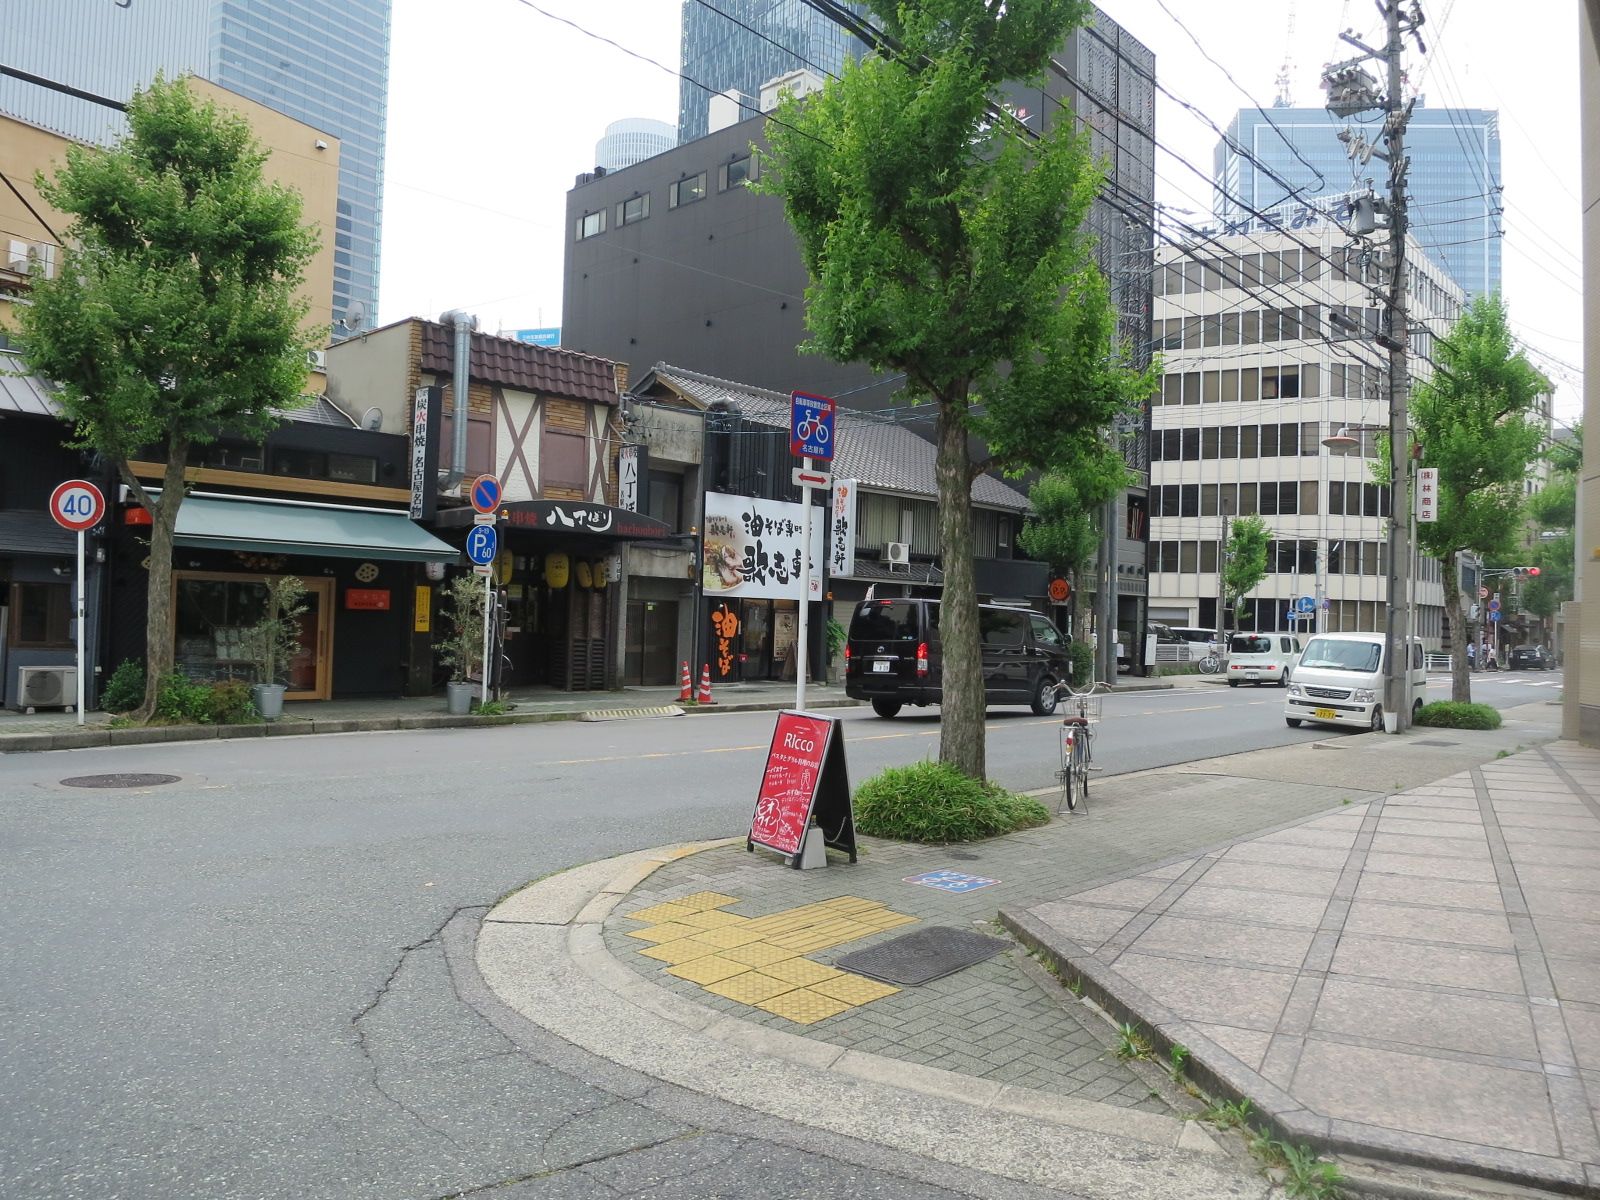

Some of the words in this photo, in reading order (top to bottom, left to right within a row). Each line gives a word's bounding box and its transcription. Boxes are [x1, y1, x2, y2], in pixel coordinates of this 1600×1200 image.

[802, 443, 825, 455] 名古屋市
[63, 494, 92, 516] 40
[545, 505, 613, 533] 八丁ぼり
[473, 534, 487, 558] P
[711, 603, 738, 677] 油そば
